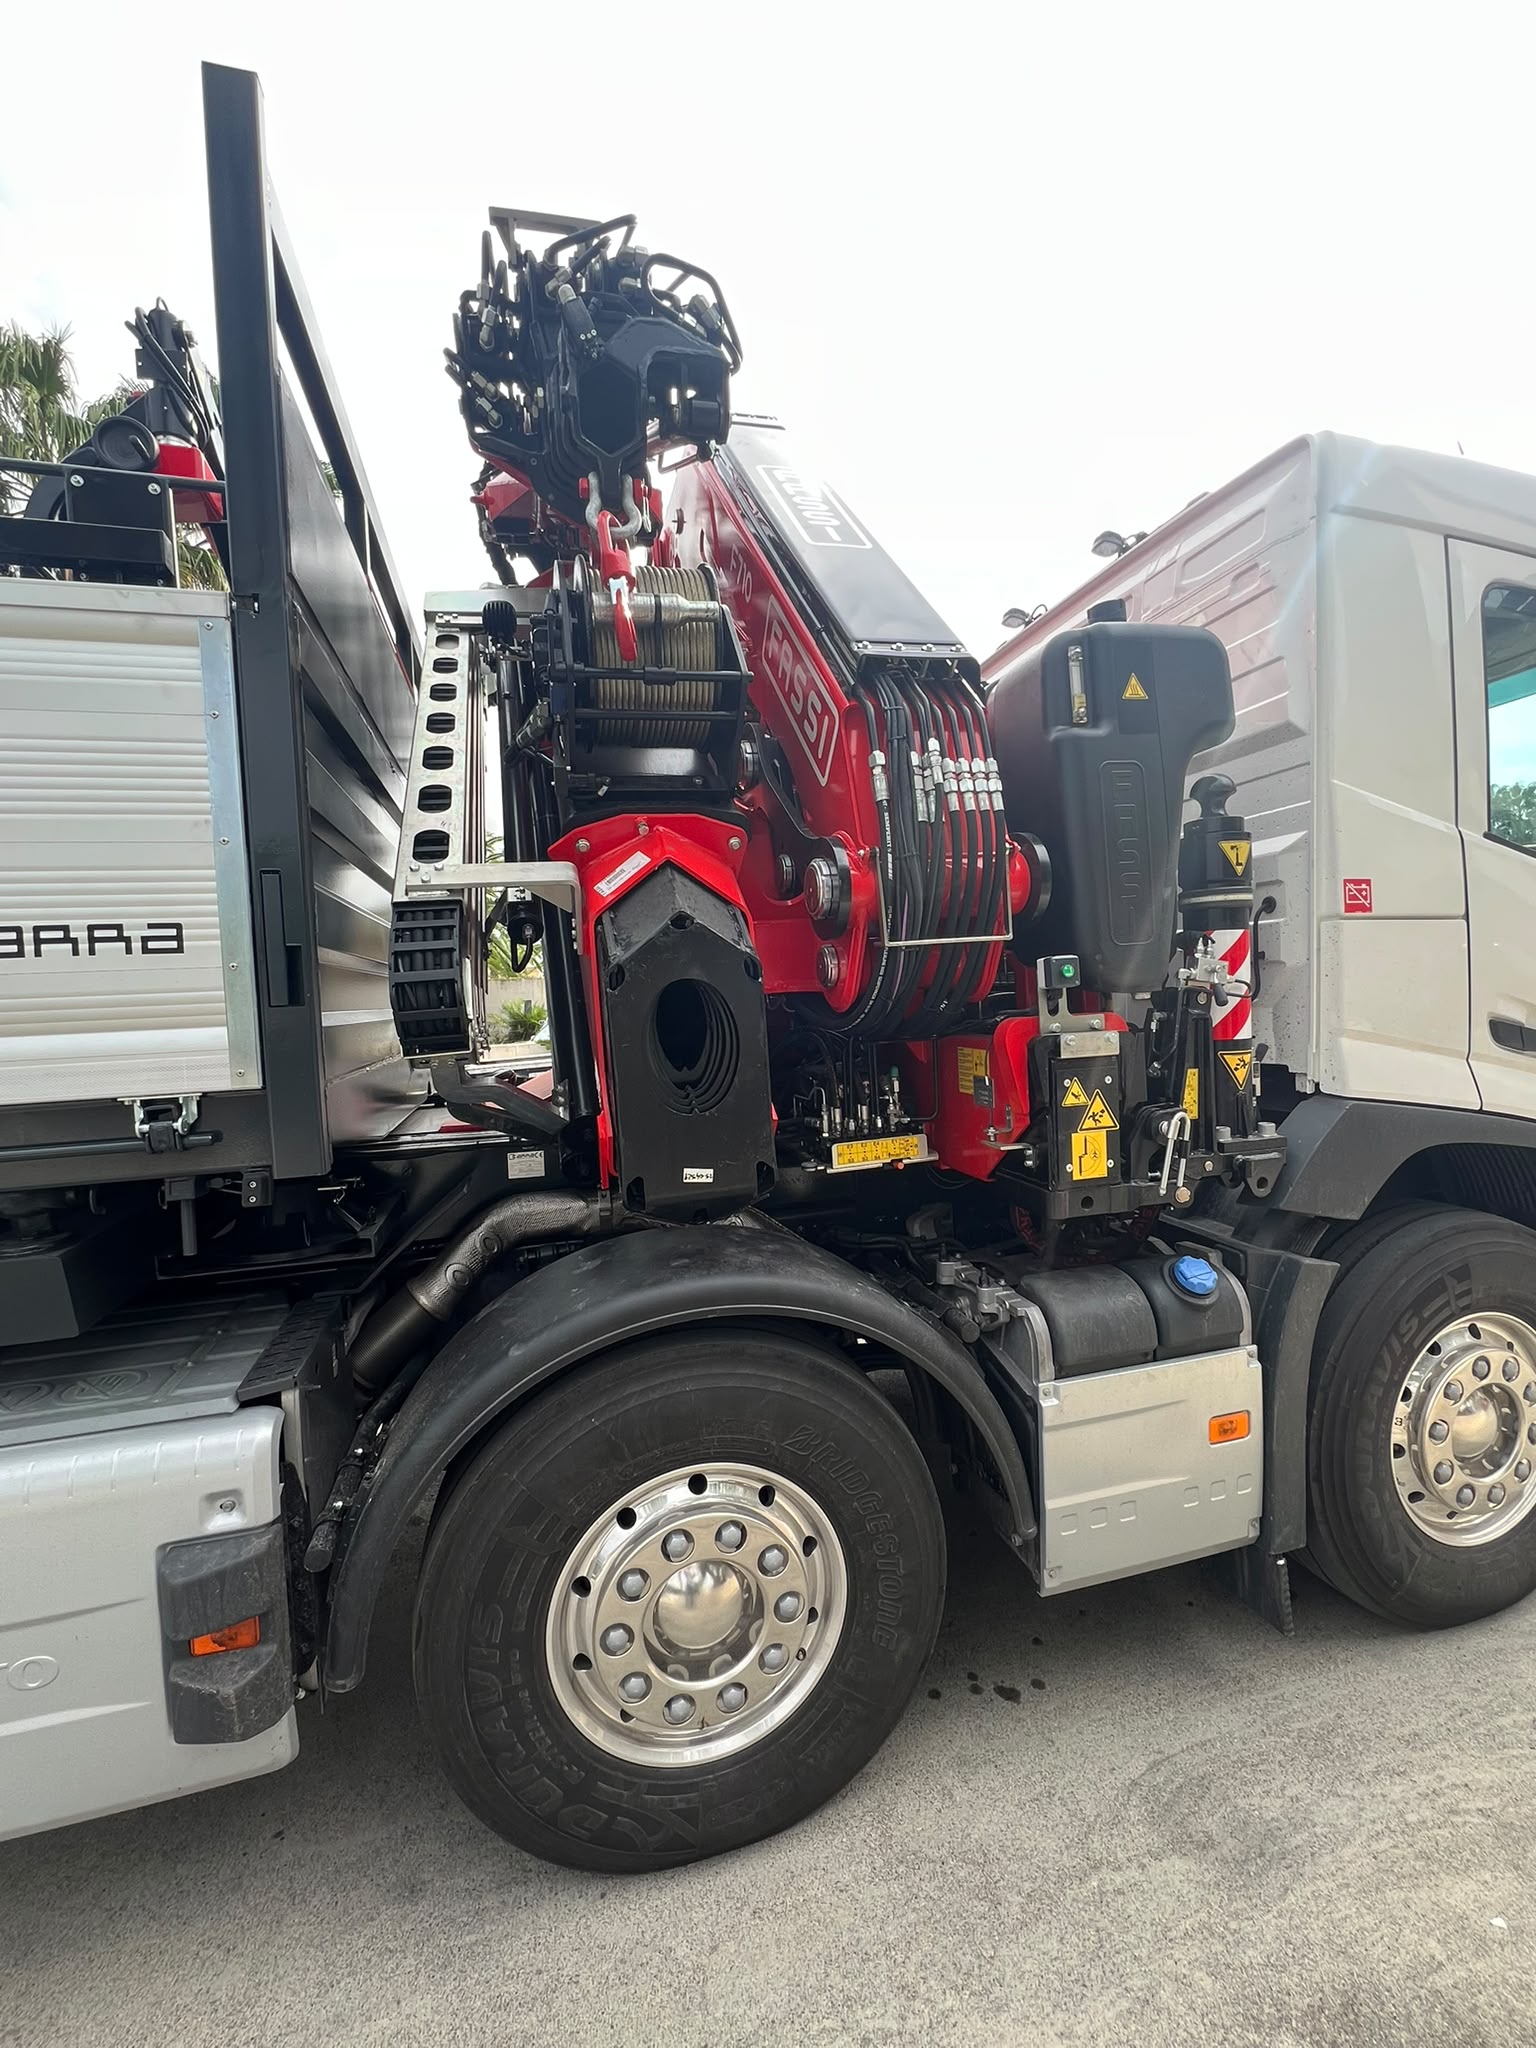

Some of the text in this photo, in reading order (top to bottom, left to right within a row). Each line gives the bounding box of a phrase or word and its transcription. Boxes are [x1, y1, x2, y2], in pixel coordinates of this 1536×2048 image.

[729, 543, 753, 605] F710
[768, 618, 829, 760] FASSI
[781, 1424, 905, 1653] BRIDGESTONE
[467, 1602, 608, 1839] DURAVIS
